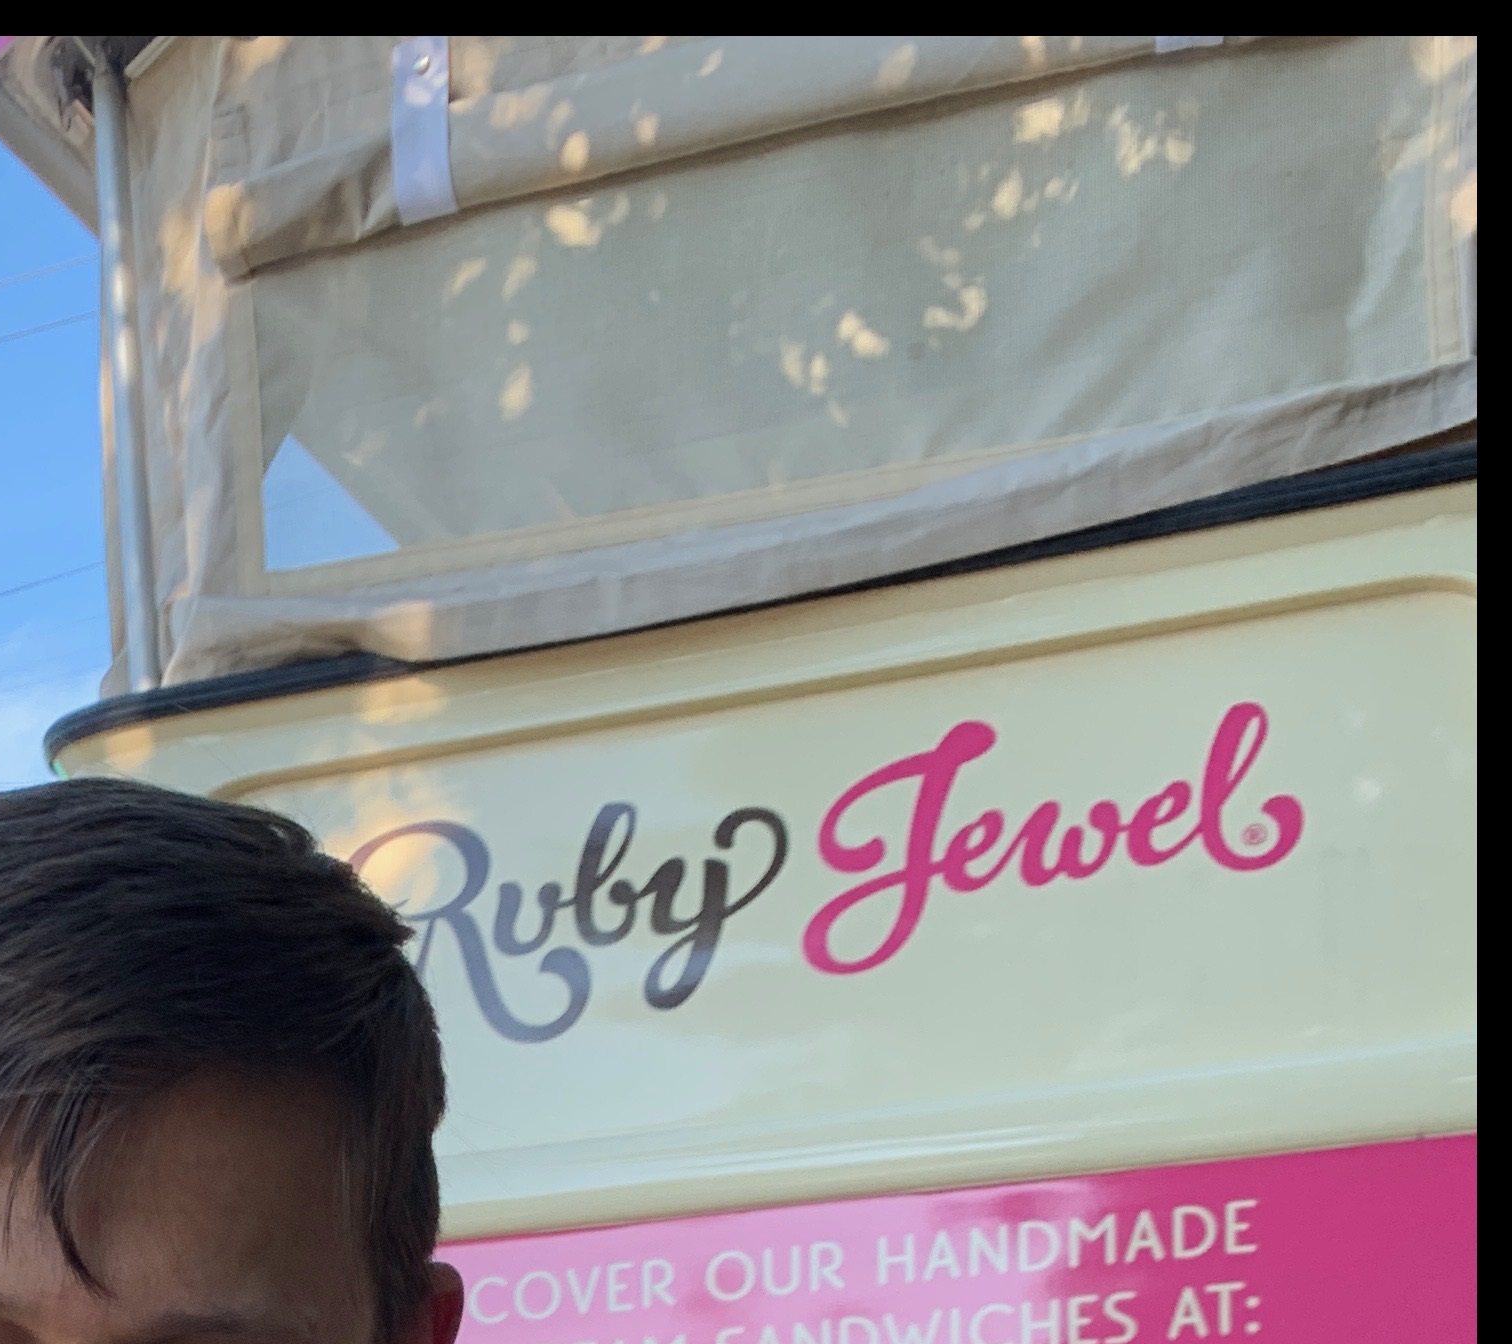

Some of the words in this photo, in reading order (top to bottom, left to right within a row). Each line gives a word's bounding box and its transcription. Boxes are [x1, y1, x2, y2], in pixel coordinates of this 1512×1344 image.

[346, 802, 790, 1043] Ruby
[803, 701, 1304, 975] Jewel
[469, 1259, 676, 1325] COVER
[705, 1240, 845, 1301] OUR
[876, 1199, 1259, 1286] HANDMADE
[1167, 1281, 1261, 1341] AT:
